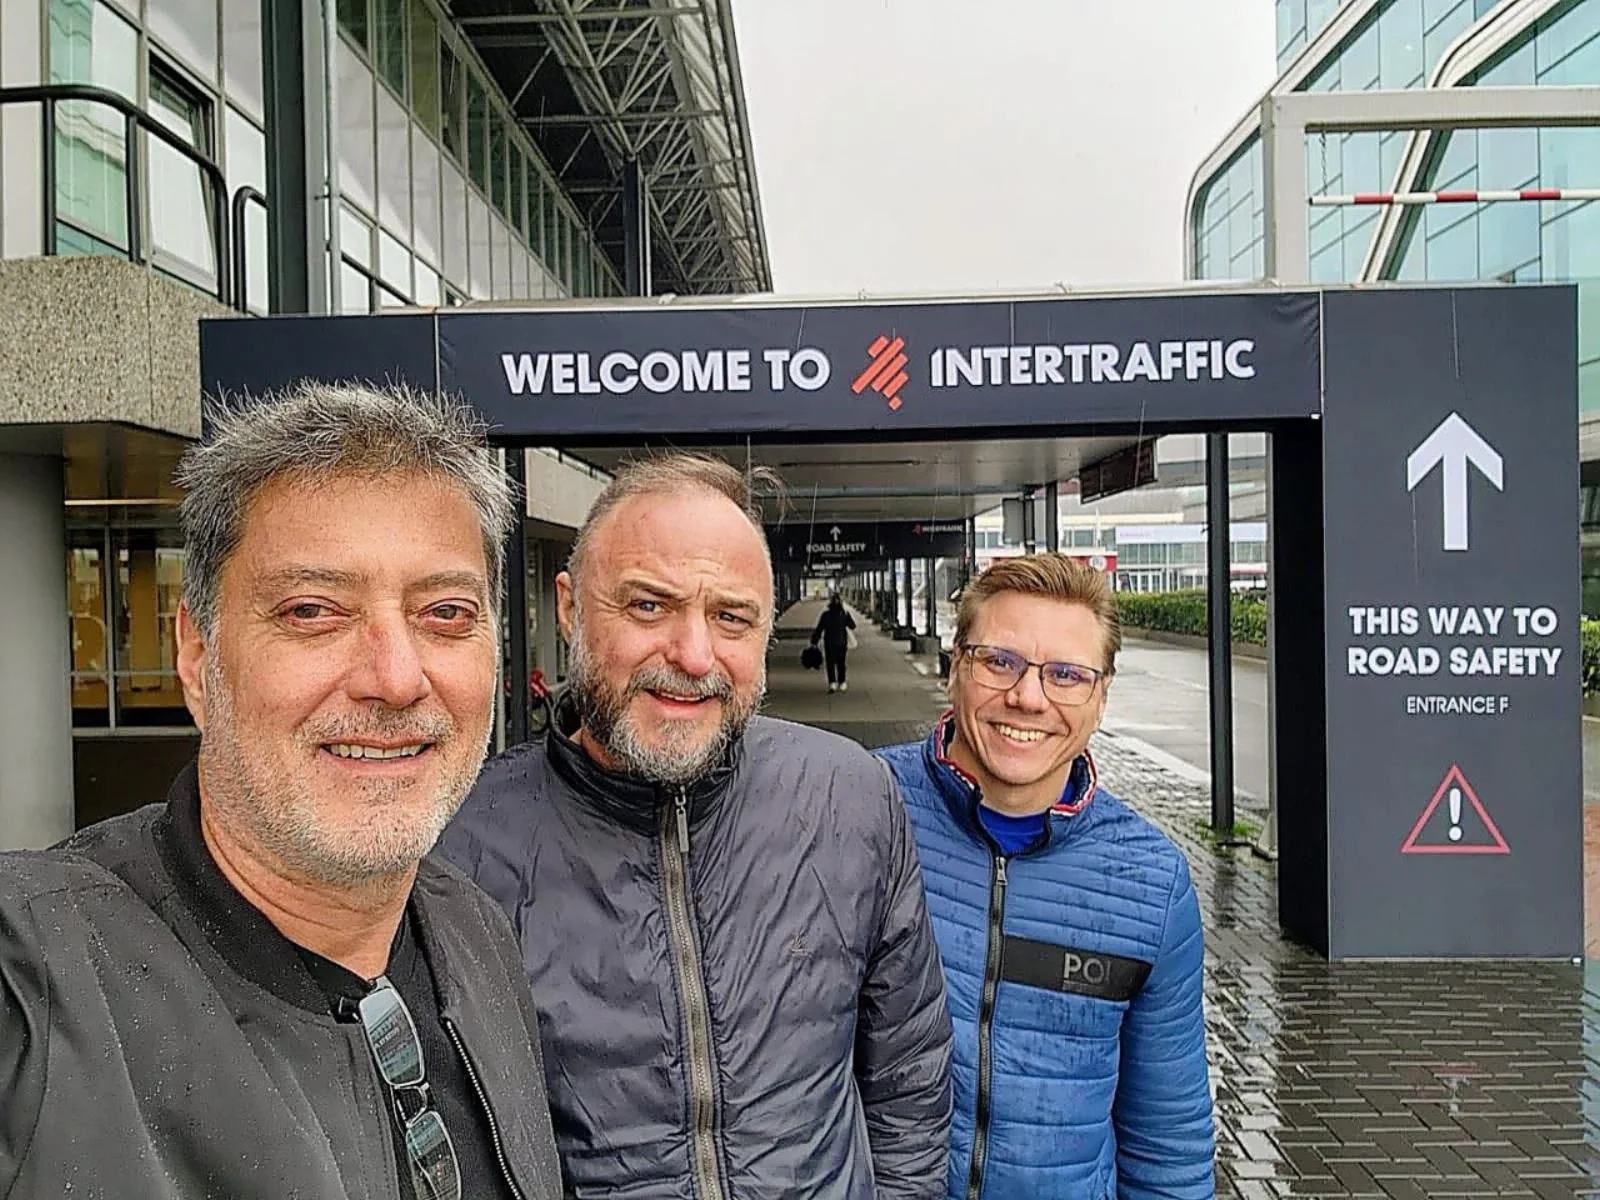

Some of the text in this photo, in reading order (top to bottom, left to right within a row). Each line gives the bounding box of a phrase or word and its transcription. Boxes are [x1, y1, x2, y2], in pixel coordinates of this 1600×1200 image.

[501, 339, 1256, 394] WELCOME TO INTERTRAFFIC
[806, 542, 866, 553] ROAD SAFETY
[1348, 607, 1558, 636] THIS WAY TO
[1348, 647, 1562, 676] ROAD SAFETY
[1406, 696, 1509, 714] ENTRANCE F
